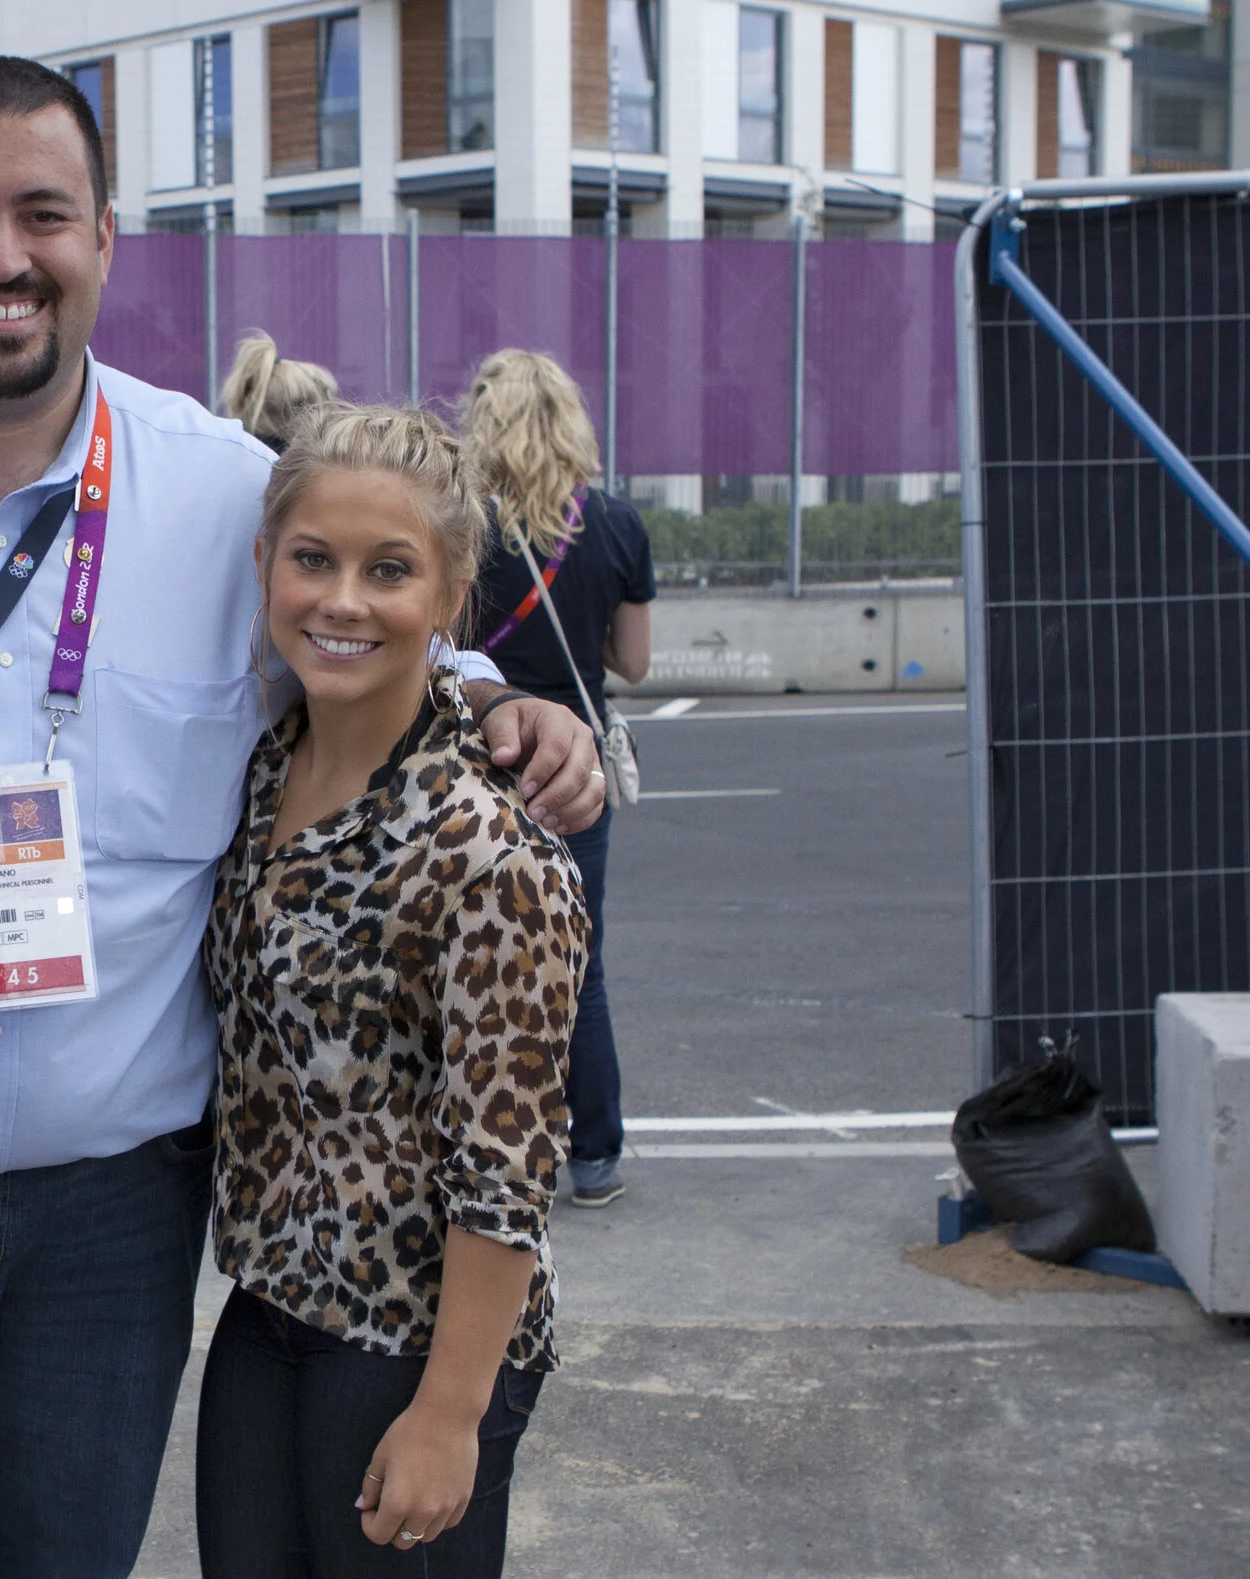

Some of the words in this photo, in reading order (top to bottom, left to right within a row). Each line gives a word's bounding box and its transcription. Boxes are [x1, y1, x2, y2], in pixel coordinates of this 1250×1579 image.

[17, 846, 41, 860] RTb
[21, 878, 54, 887] PERSONNEL
[7, 932, 24, 942] MPC
[7, 968, 21, 986] 4
[27, 966, 39, 985] 5
